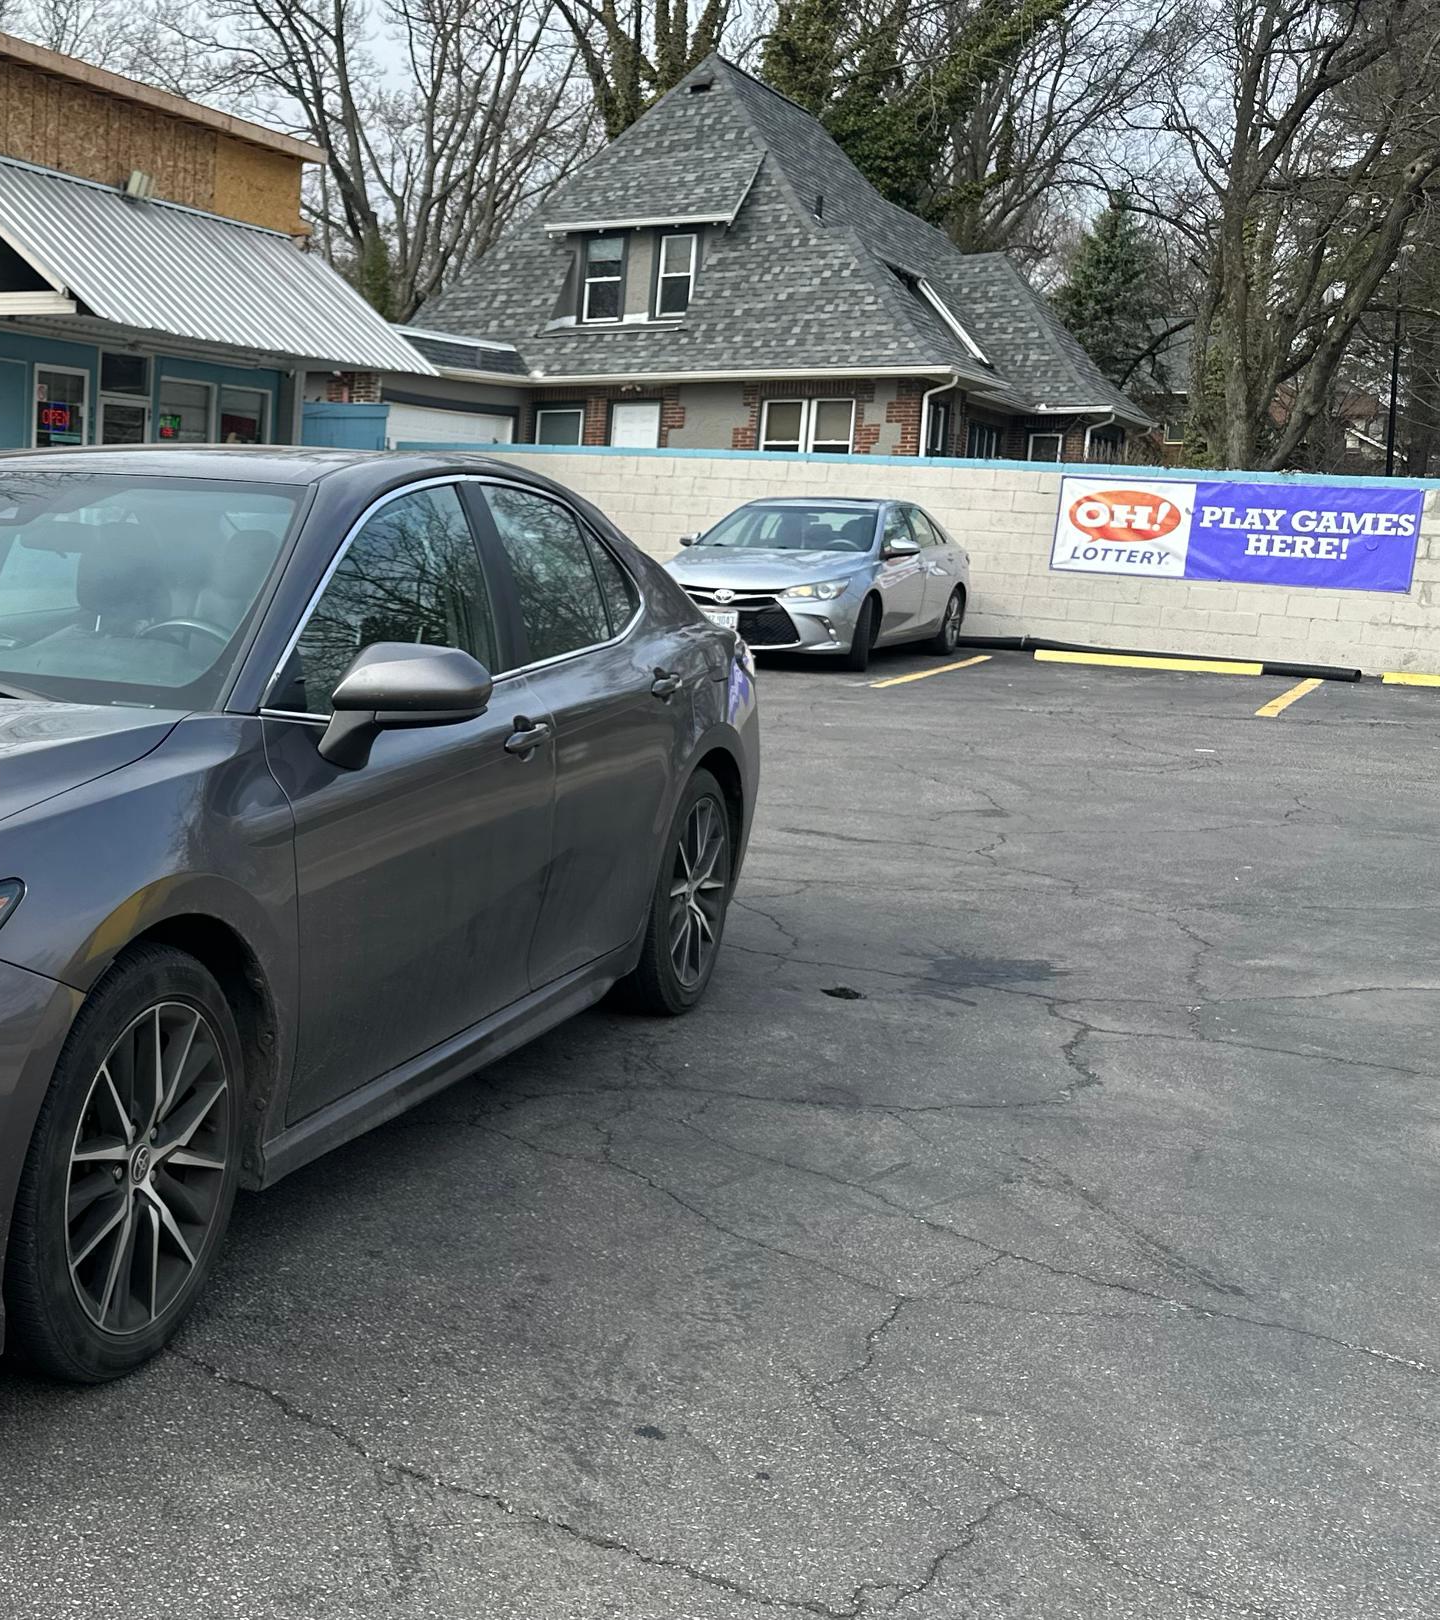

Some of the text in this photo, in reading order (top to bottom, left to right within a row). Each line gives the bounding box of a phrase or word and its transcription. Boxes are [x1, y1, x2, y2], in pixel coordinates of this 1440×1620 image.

[42, 409, 69, 426] OPEN
[1075, 501, 1172, 532] OH!
[1200, 506, 1415, 537] PLAY GAMES
[1070, 546, 1170, 565] LOTTERY
[1244, 534, 1350, 560] HERE!
